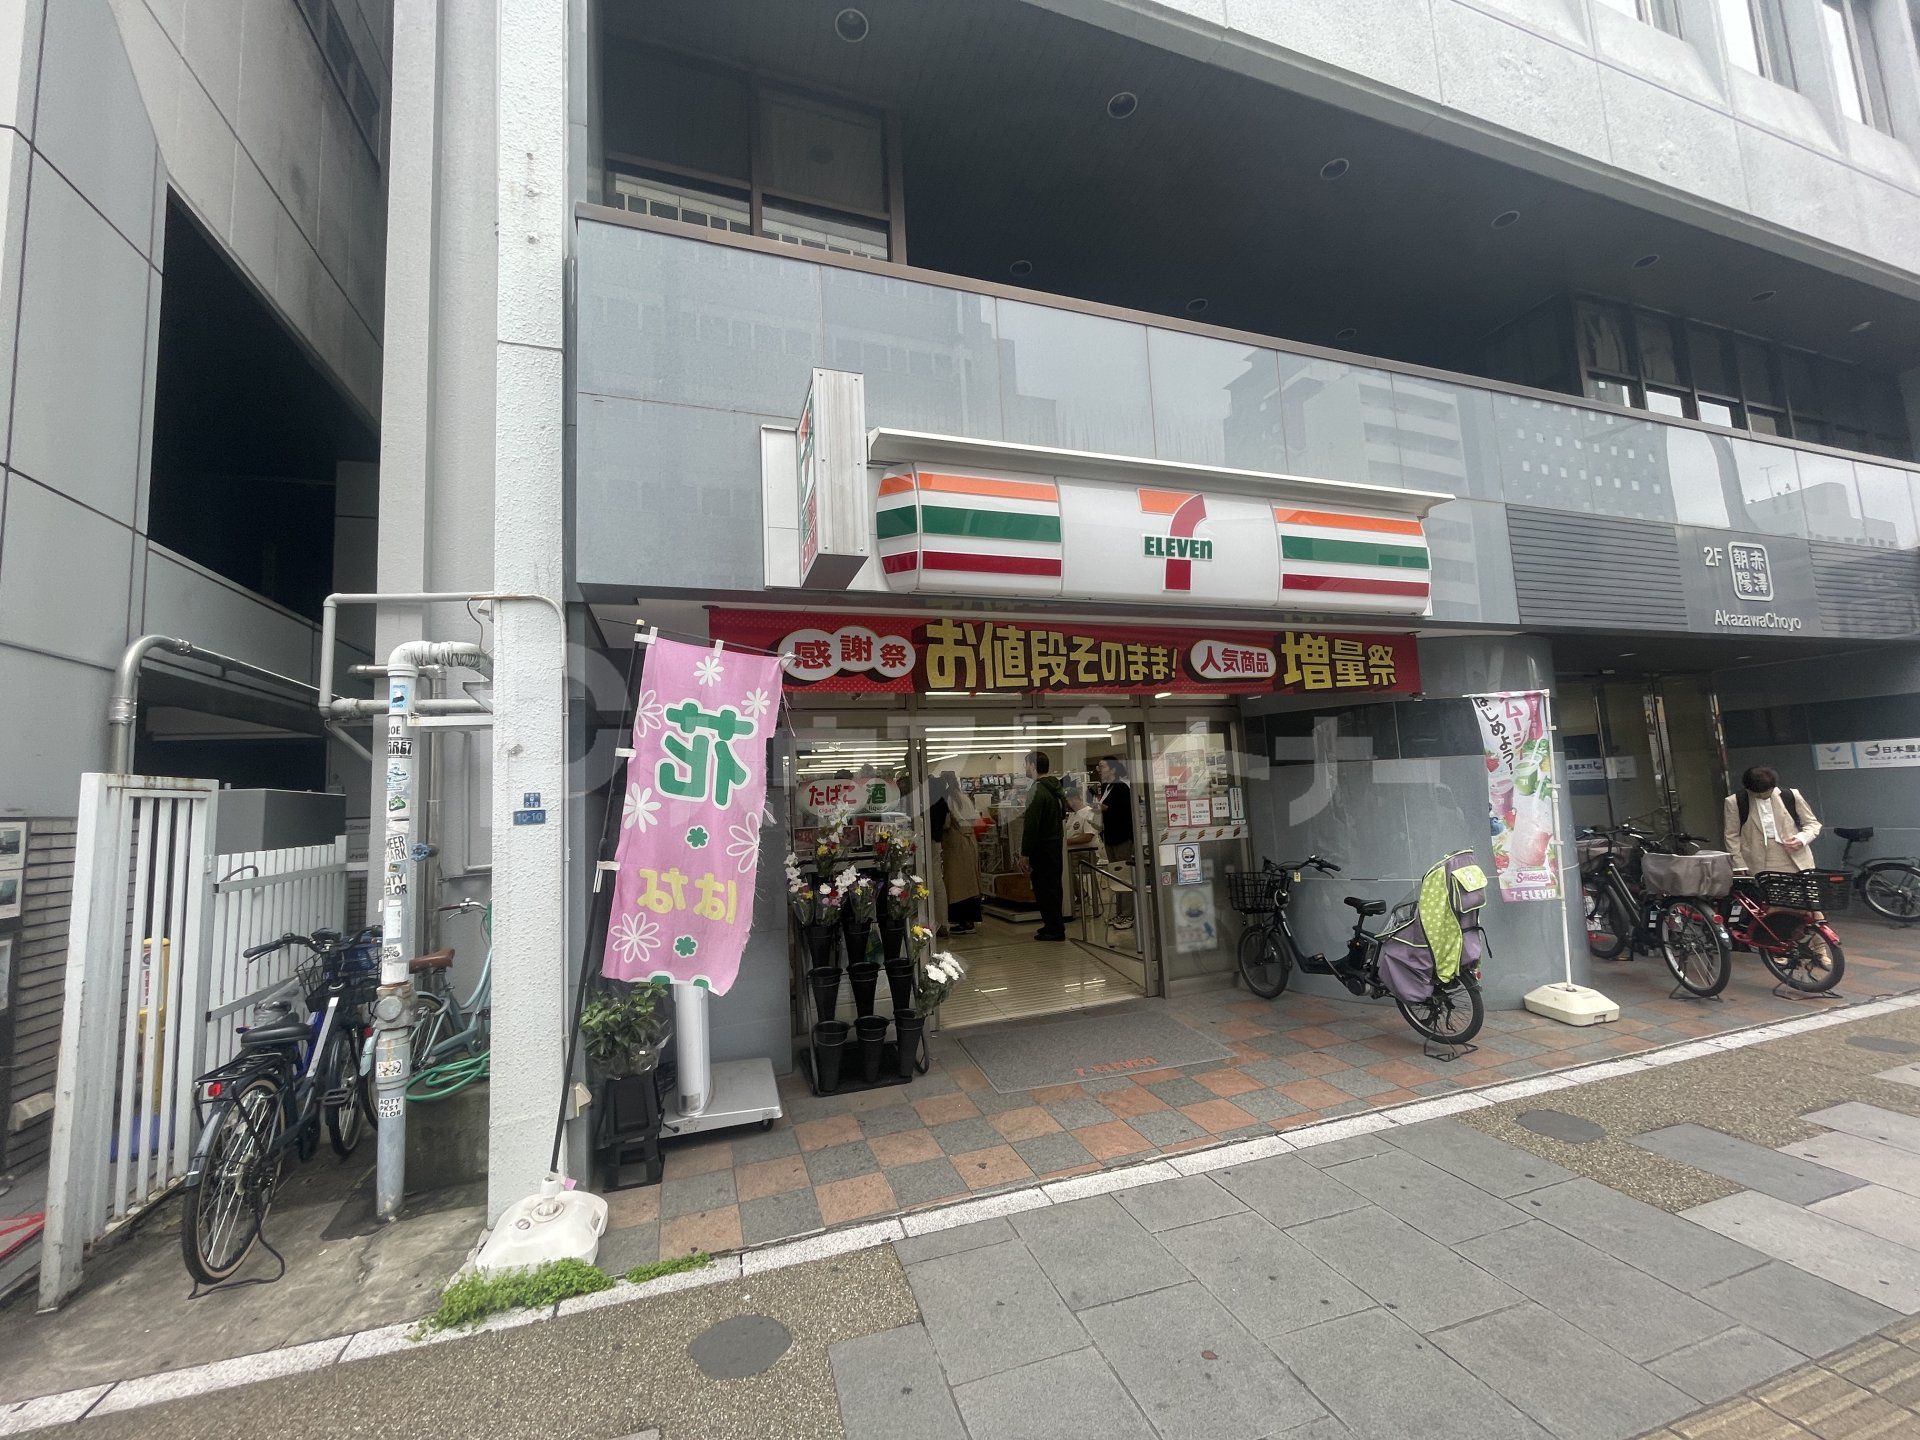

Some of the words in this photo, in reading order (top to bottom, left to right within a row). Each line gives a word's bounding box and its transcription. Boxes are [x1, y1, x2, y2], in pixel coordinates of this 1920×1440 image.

[1138, 488, 1207, 592] 7
[1703, 546, 1723, 567] 2F
[1714, 609, 1802, 632] AkazawaChoyo
[793, 634, 907, 670] 感謝祭
[1200, 645, 1269, 674] 人気商品
[1280, 630, 1397, 691] 増量祭
[808, 784, 857, 807] たばこ
[865, 783, 887, 805] 酒
[516, 812, 543, 823] 10-10
